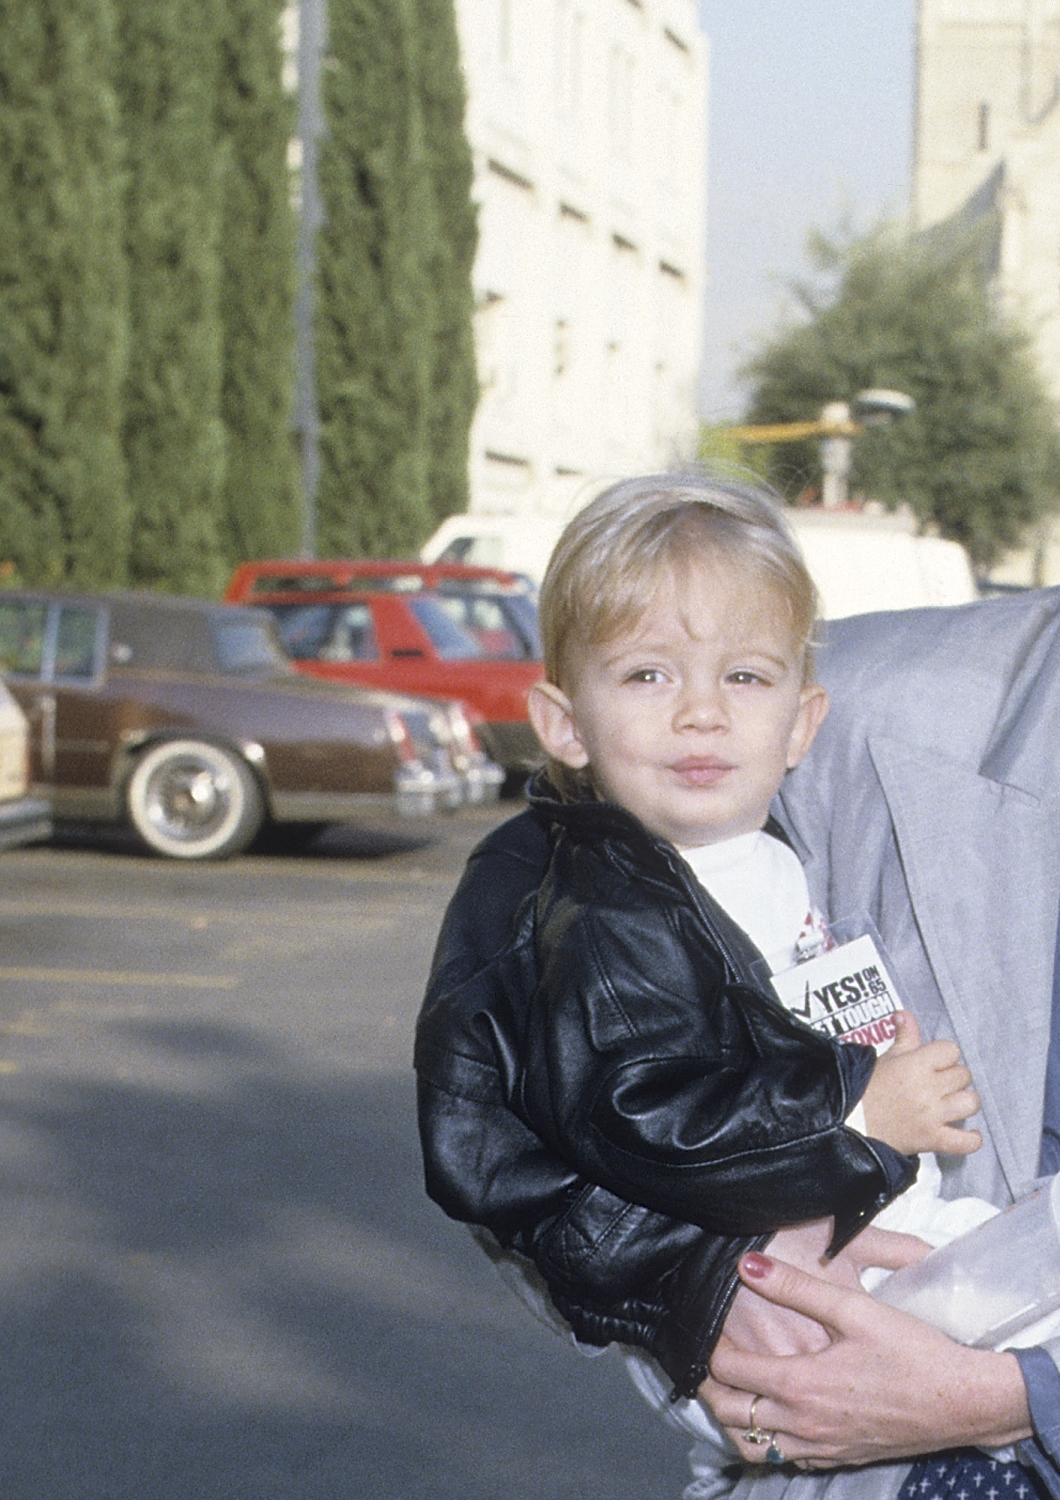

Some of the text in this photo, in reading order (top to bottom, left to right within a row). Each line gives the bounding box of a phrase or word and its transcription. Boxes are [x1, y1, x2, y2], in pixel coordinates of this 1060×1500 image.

[862, 964, 880, 981] ON
[868, 977, 887, 994] 65
[813, 972, 869, 1013] YES!
[834, 993, 894, 1032] TOUGH
